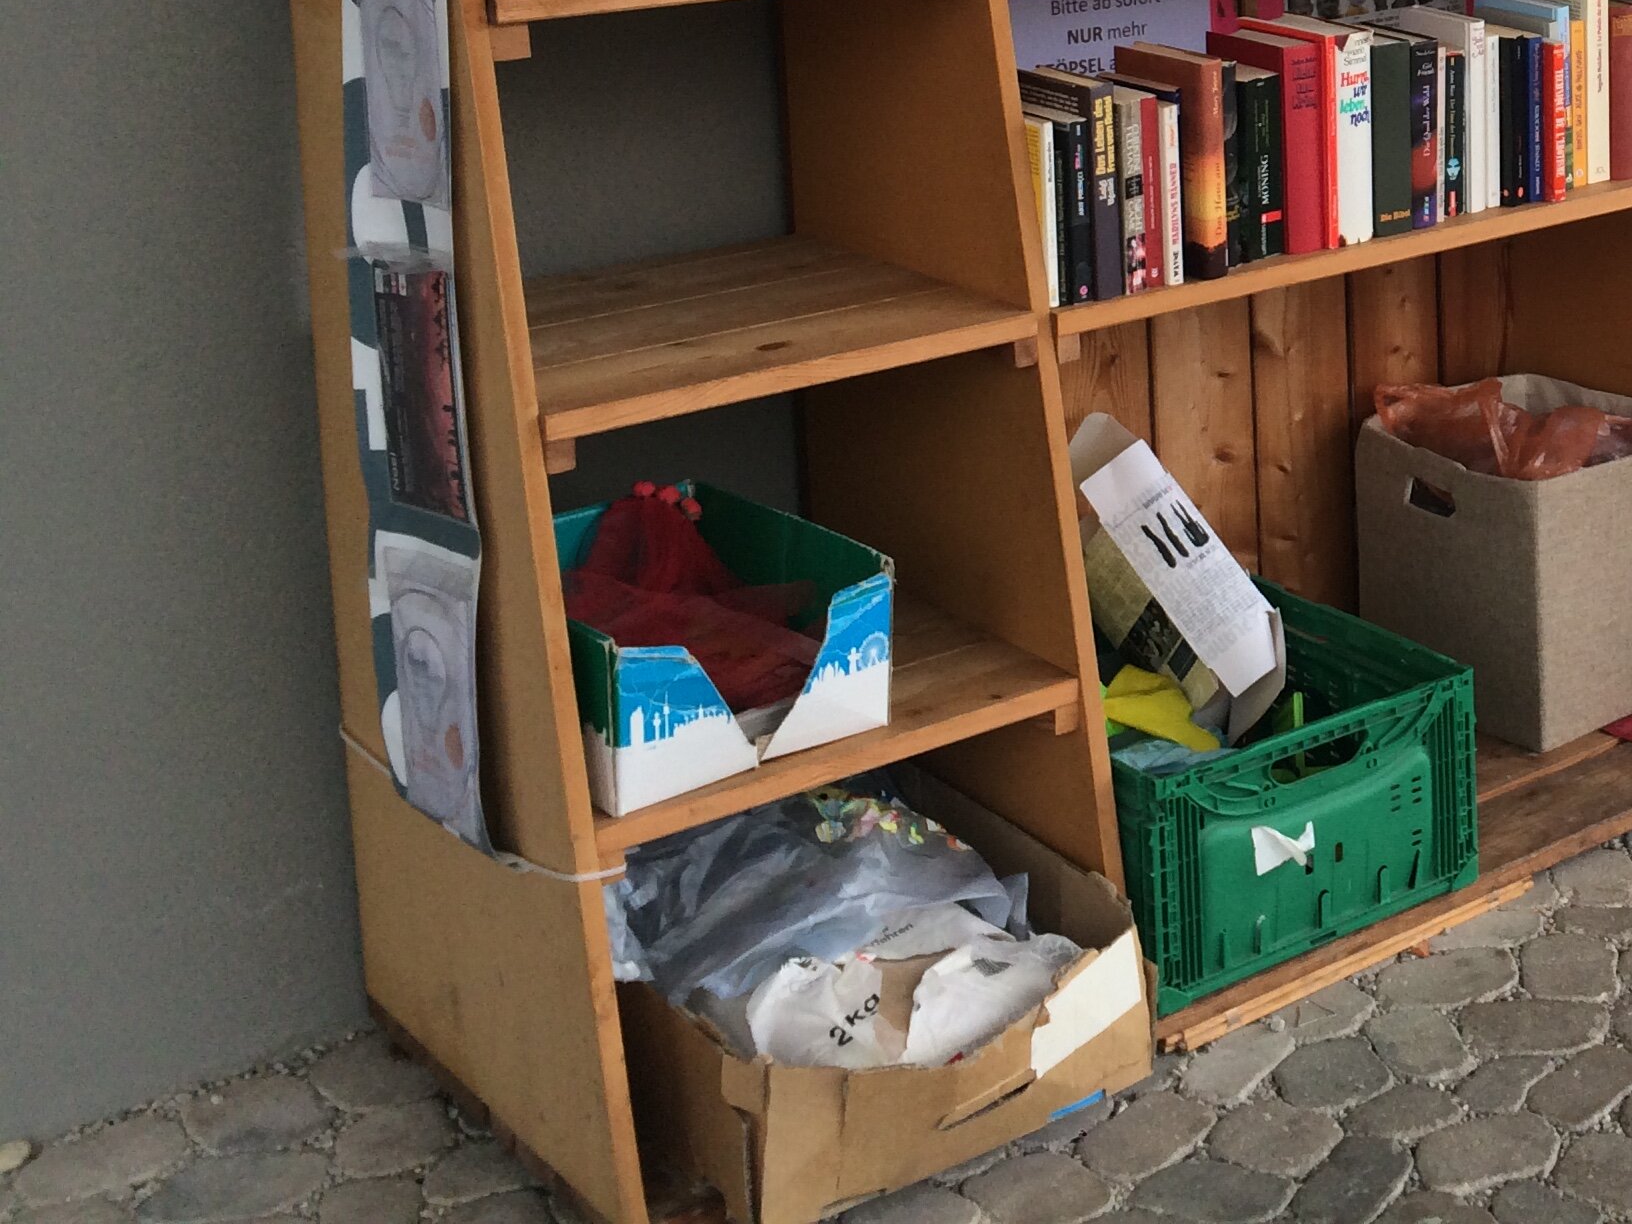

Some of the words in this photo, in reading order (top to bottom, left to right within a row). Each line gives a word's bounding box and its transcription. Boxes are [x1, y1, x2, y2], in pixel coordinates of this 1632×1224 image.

[1066, 27, 1103, 45] NUR
[1107, 20, 1148, 41] mehr
[1261, 153, 1270, 206] MONING
[830, 1025, 851, 1047] 2
